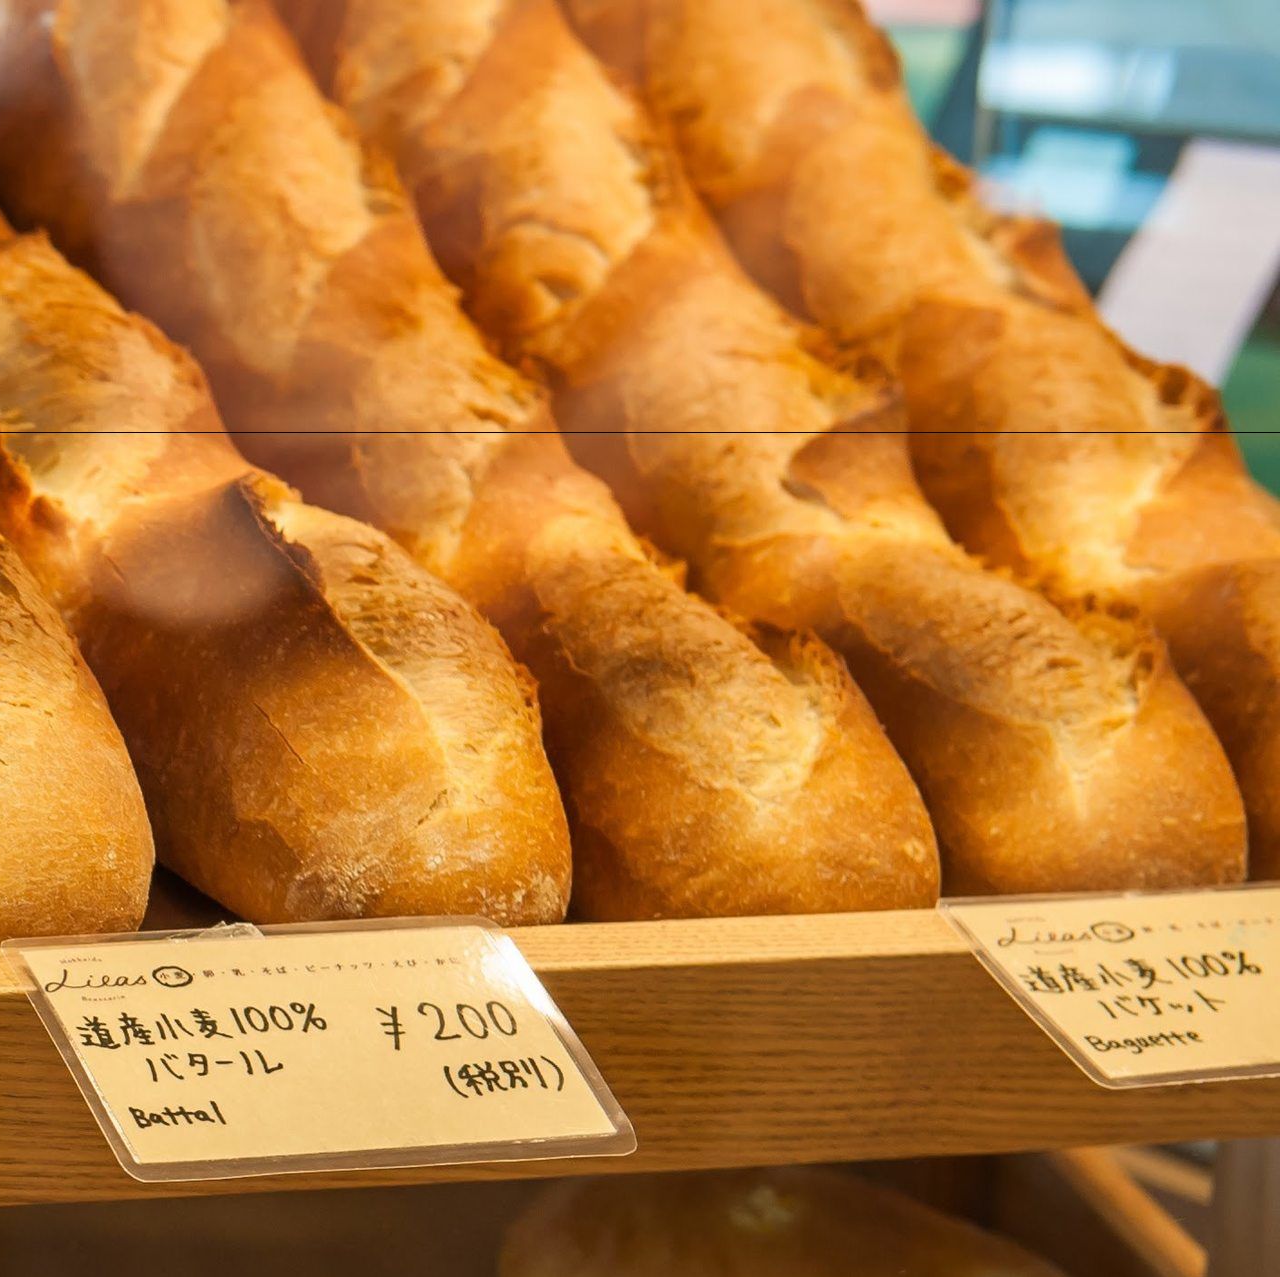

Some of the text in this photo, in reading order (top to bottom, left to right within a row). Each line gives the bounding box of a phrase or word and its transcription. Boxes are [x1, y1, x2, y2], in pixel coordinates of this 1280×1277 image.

[76, 1001, 328, 1050] 道産小麦100%
[375, 1001, 519, 1051] ¥200
[1084, 1030, 1204, 1054] Baguette
[145, 1049, 284, 1082] バタール
